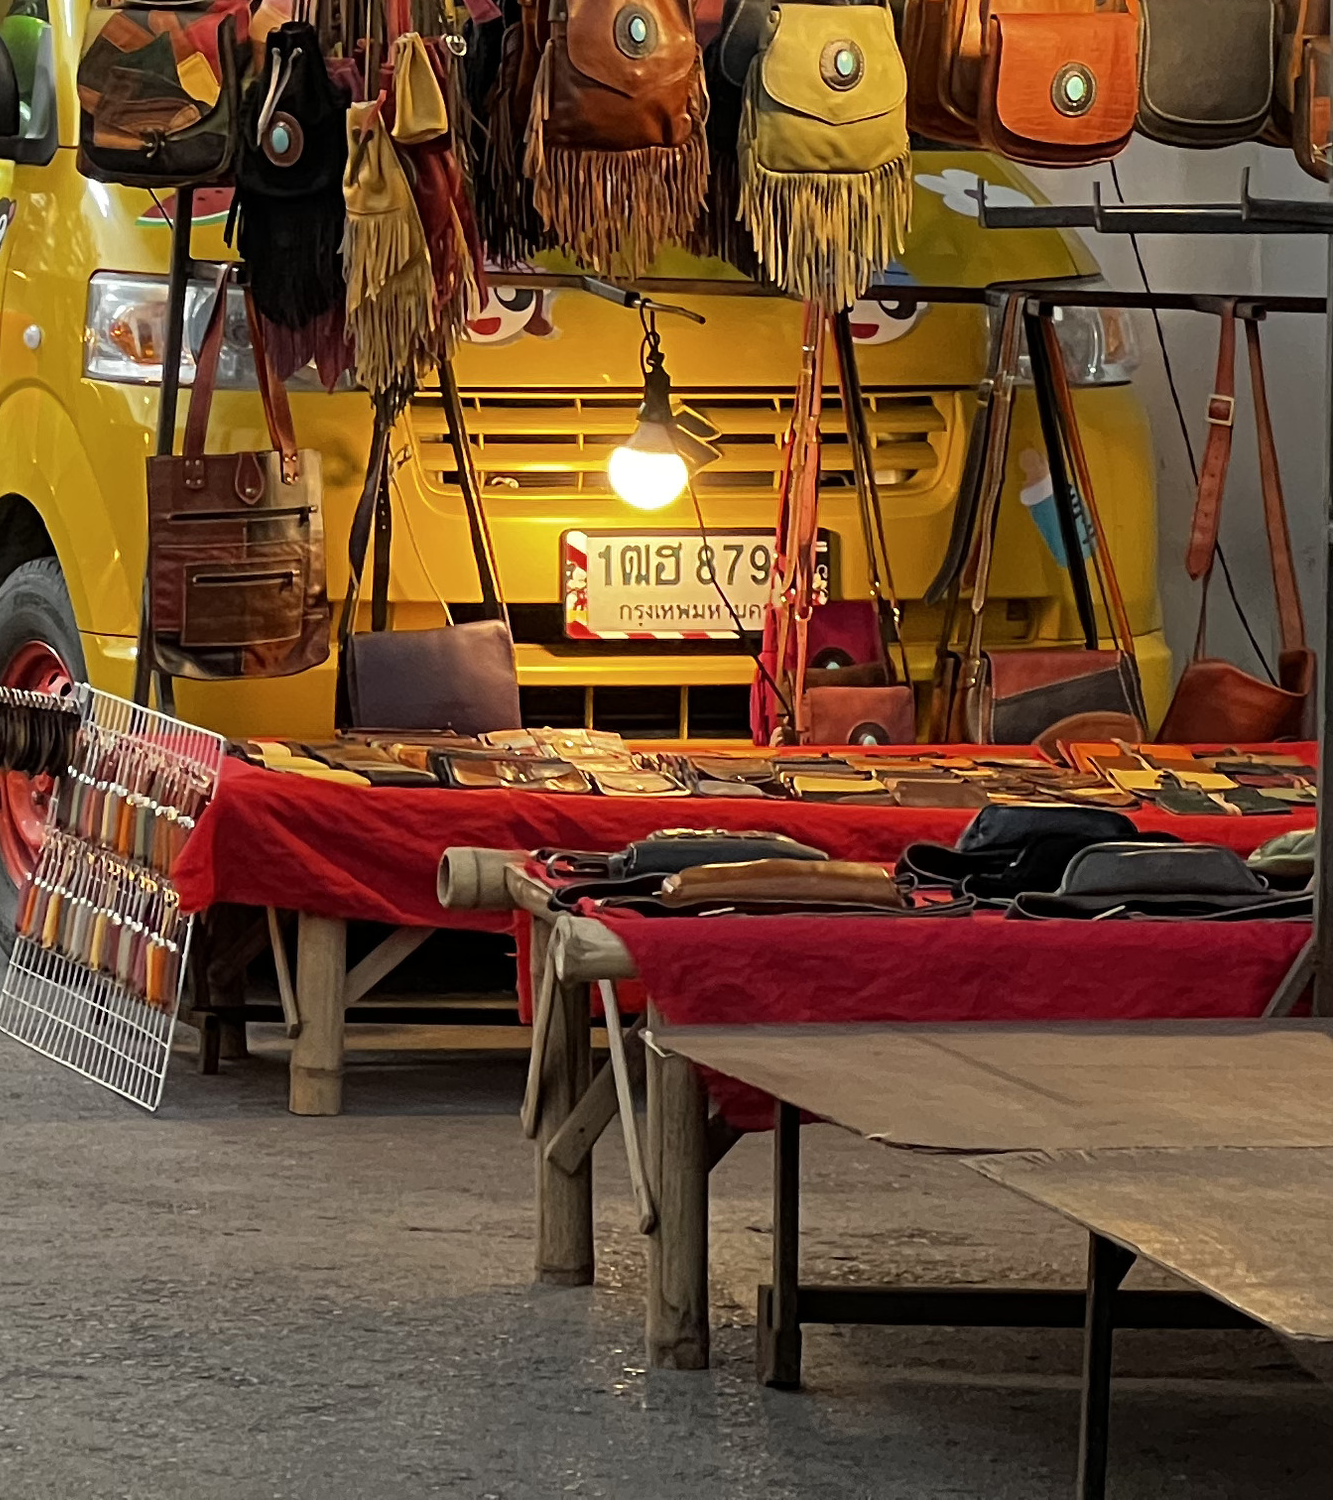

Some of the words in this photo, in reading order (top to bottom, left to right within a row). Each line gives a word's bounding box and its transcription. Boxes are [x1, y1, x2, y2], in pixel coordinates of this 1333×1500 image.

[598, 542, 682, 586] 1ฒฮ
[696, 544, 771, 586] 879
[620, 603, 766, 627] กรุงเทพมหานค
